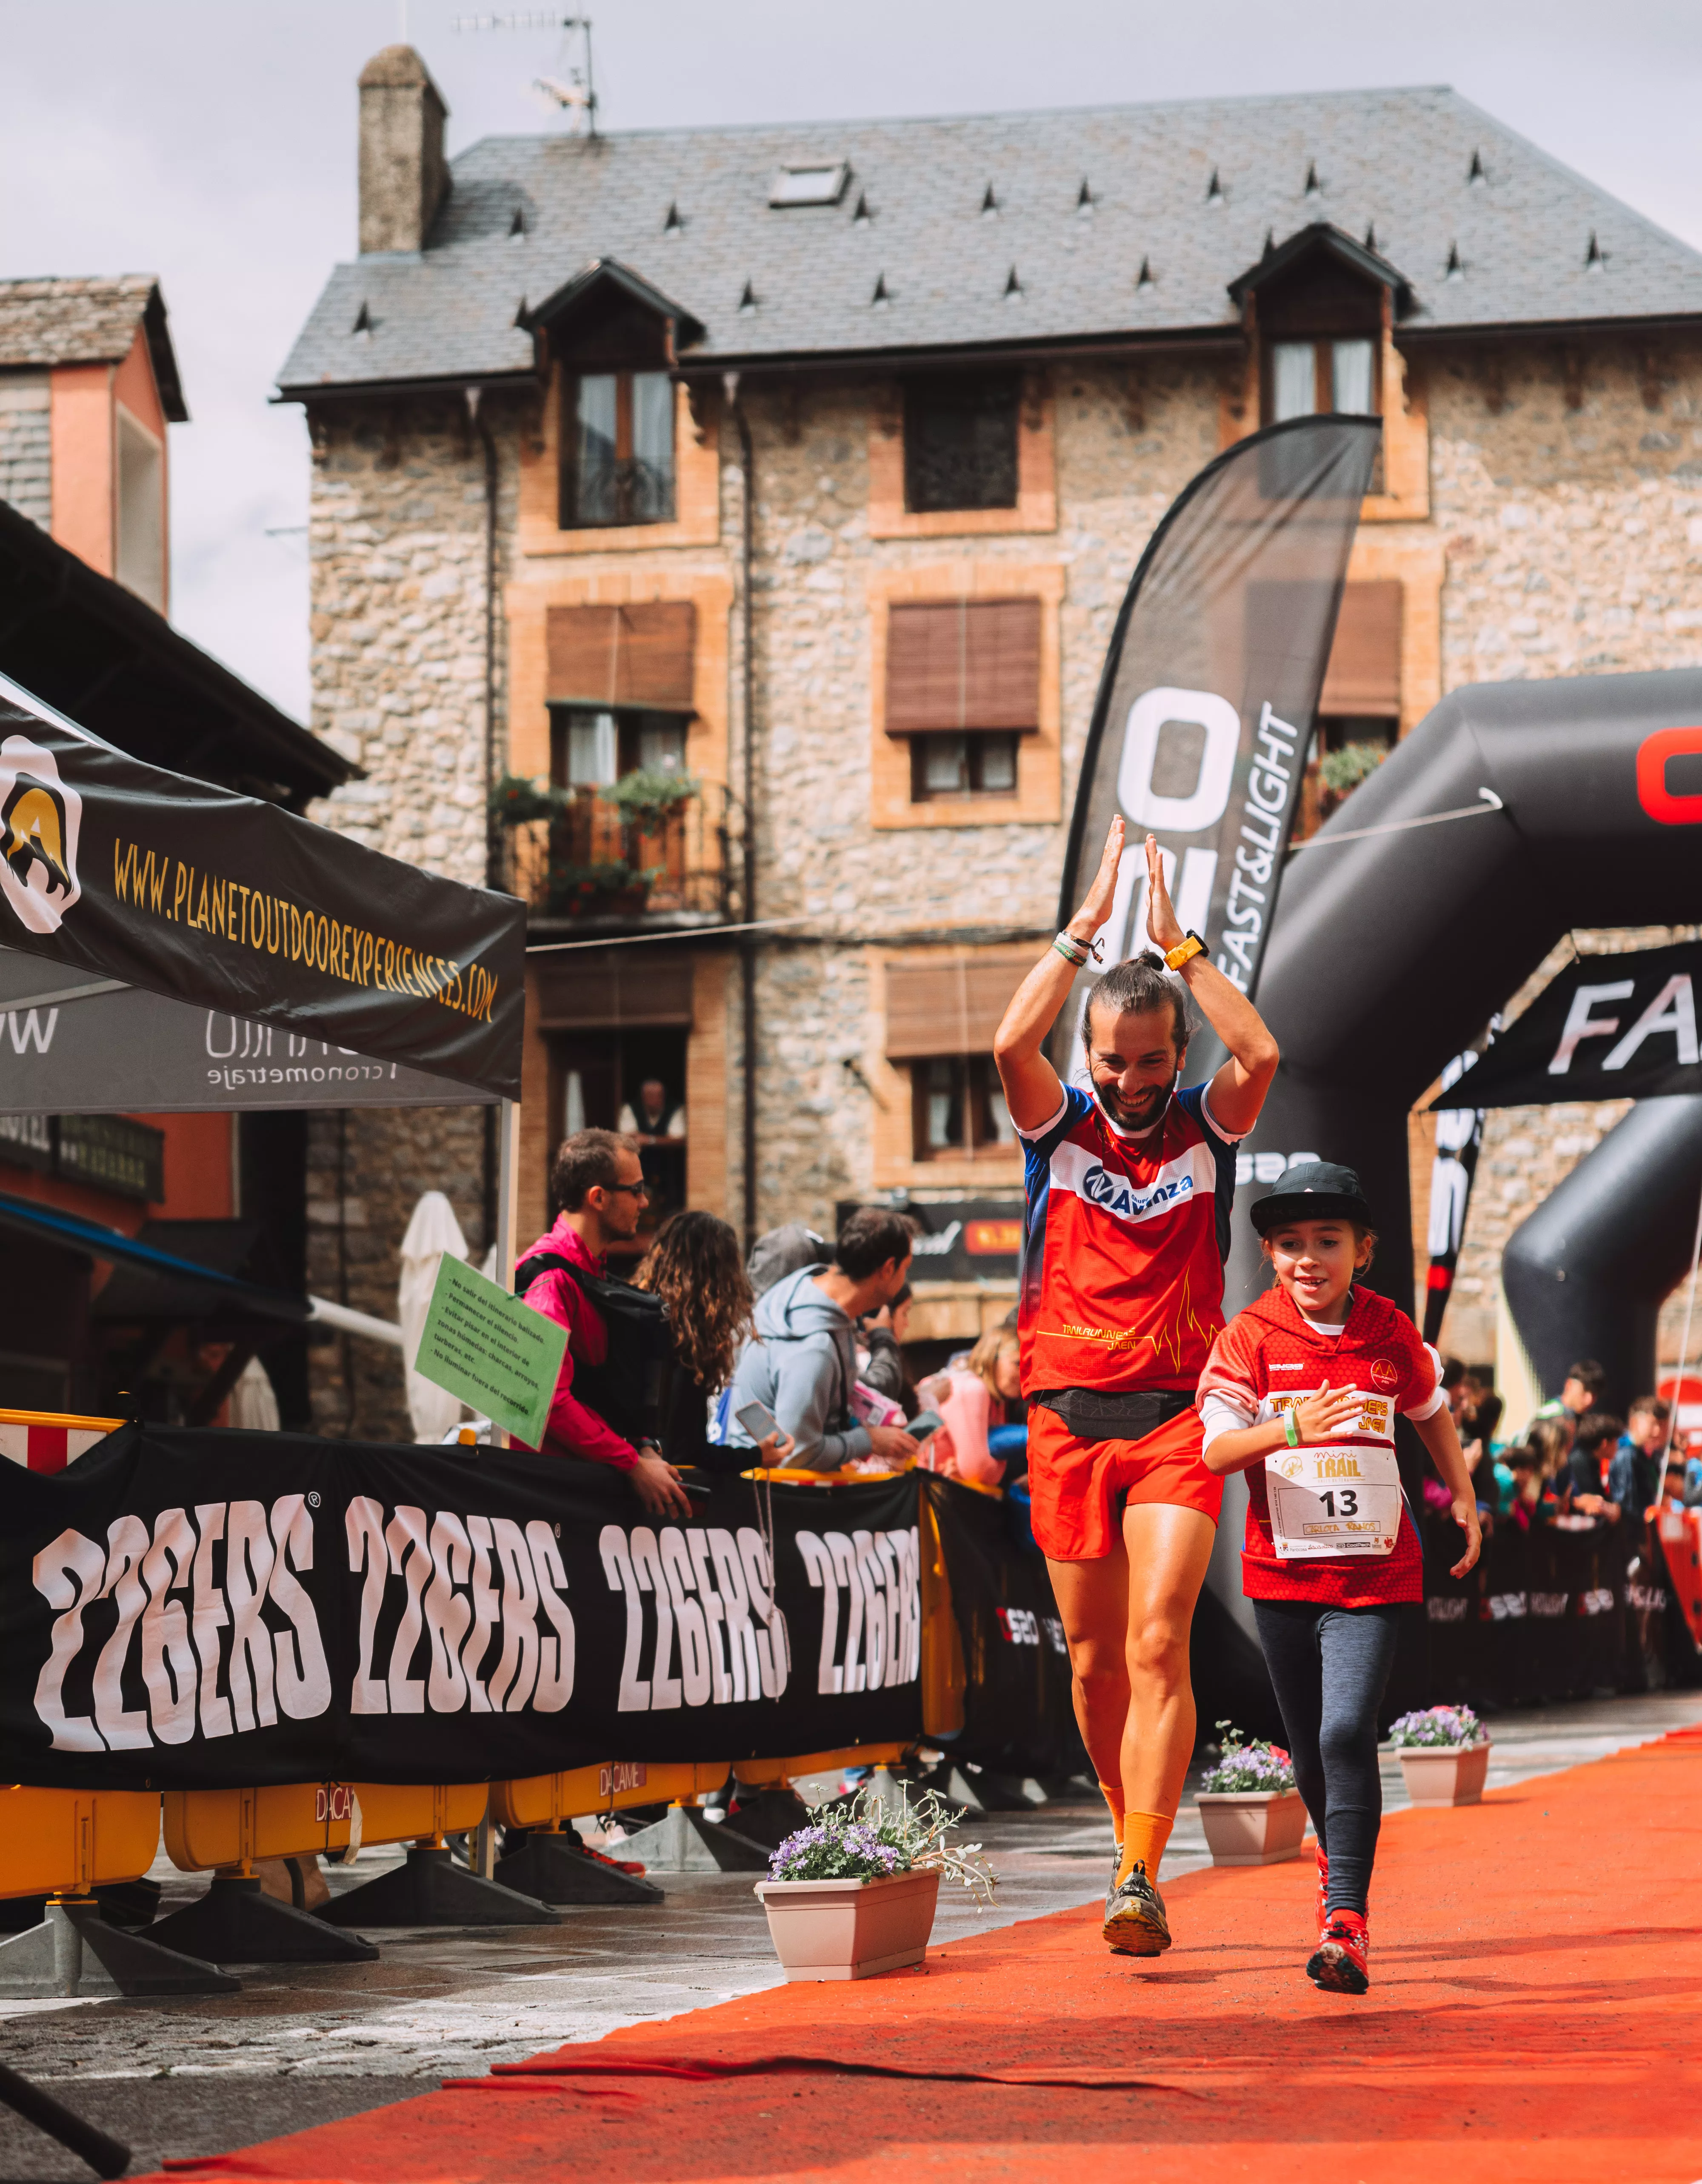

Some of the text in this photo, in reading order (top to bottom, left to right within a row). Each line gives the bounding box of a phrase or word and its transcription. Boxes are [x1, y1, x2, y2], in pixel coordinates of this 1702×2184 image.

[114, 838, 498, 1023] WWW.PLANETOUTDOOREXPERIENCES.COM
[1548, 973, 1702, 1075] FA
[448, 1293, 486, 1321] Permanecer
[452, 1278, 462, 1289] No
[463, 1286, 477, 1299] salir
[477, 1296, 488, 1306] del
[488, 1302, 517, 1326] itinerario
[437, 1319, 456, 1335] zonas
[445, 1307, 464, 1323] Evitar
[464, 1320, 481, 1334] pisar
[481, 1331, 489, 1340] en
[497, 1342, 521, 1361] interior
[522, 1358, 530, 1367] de
[464, 1353, 475, 1364] etc.
[1108, 1341, 1136, 1350] JAEN
[434, 1349, 443, 1359] No
[444, 1355, 471, 1377] iluminar
[472, 1373, 488, 1389] fuera
[490, 1385, 500, 1396] del
[1359, 1416, 1386, 1433] JAEN
[1314, 1457, 1361, 1478] TRAIL
[1319, 1490, 1358, 1517] 13
[317, 1787, 354, 1821] DACA
